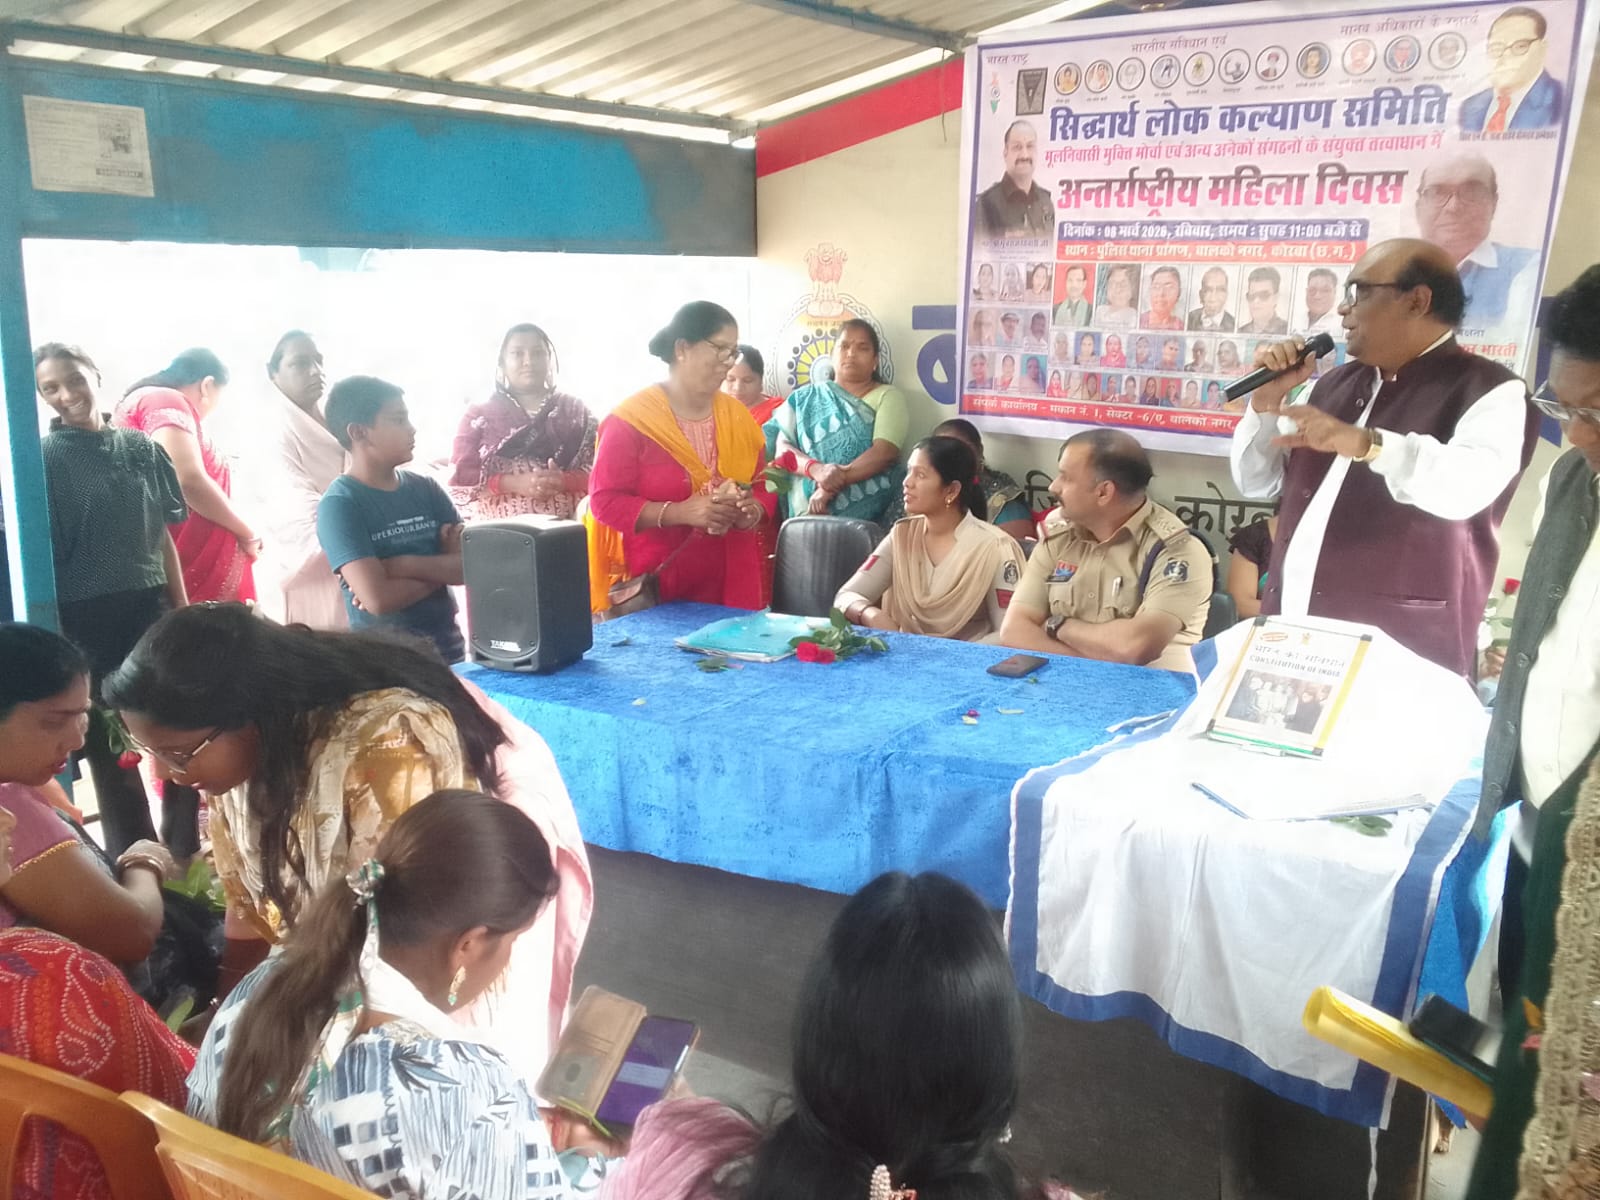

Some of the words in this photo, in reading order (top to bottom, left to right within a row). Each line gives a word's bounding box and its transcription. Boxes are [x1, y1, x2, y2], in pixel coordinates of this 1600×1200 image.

[1049, 100, 1140, 141] सिद्धार्थ
[1145, 99, 1212, 137] लोक
[1219, 99, 1338, 133] कल्याण
[1343, 84, 1453, 128] समिति
[1045, 146, 1101, 168] मूलनिवासी
[1103, 144, 1133, 165] मुक्ति
[1136, 141, 1162, 160] मोर्चा
[1165, 140, 1182, 159] एवं
[1185, 143, 1211, 158] अन्य
[1214, 138, 1256, 157] अनेकों
[1257, 136, 1303, 155] संगठनों
[1305, 134, 1318, 153] के
[1323, 134, 1365, 158] संयुक्त
[1431, 130, 1445, 149] में
[1057, 166, 1203, 217] अन्तर्राष्ट्रीय
[1208, 164, 1310, 206] महिला
[1315, 161, 1409, 205] दिवस
[1063, 222, 1095, 238] दिनांक
[1104, 226, 1117, 238] 08
[1119, 222, 1141, 237] मार्च
[1218, 224, 1248, 237] समय
[1259, 223, 1288, 240] सुबह
[1290, 225, 1322, 237] 11:00
[1324, 220, 1347, 237] बजे
[1349, 220, 1362, 237] से
[1097, 242, 1127, 259] पुलिस
[1271, 241, 1308, 257] कोरबा
[1106, 405, 1134, 420] सेक्टर
